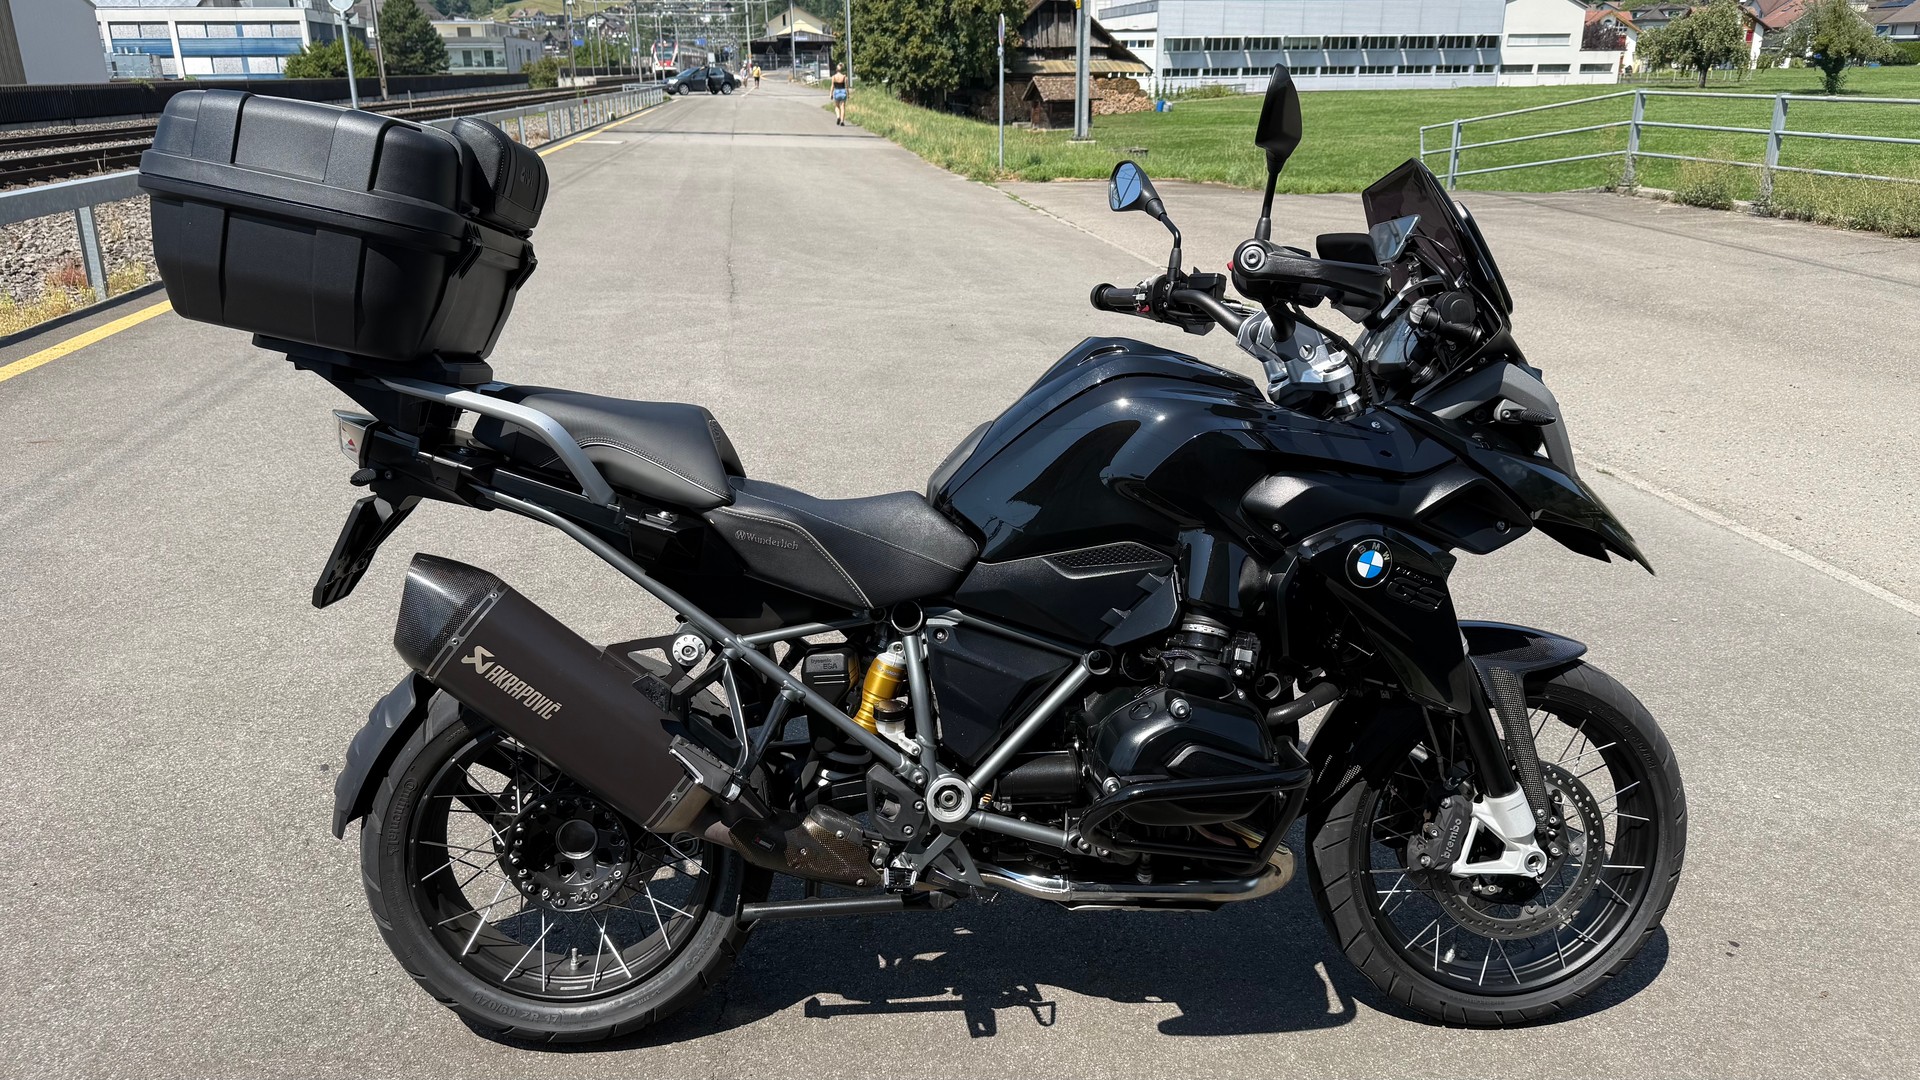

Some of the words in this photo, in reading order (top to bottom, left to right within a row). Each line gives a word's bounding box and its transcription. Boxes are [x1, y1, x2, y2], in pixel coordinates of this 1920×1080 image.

[746, 532, 799, 550] Wunderlich
[1440, 818, 1462, 859] brembo
[519, 1010, 540, 1022] ZR
